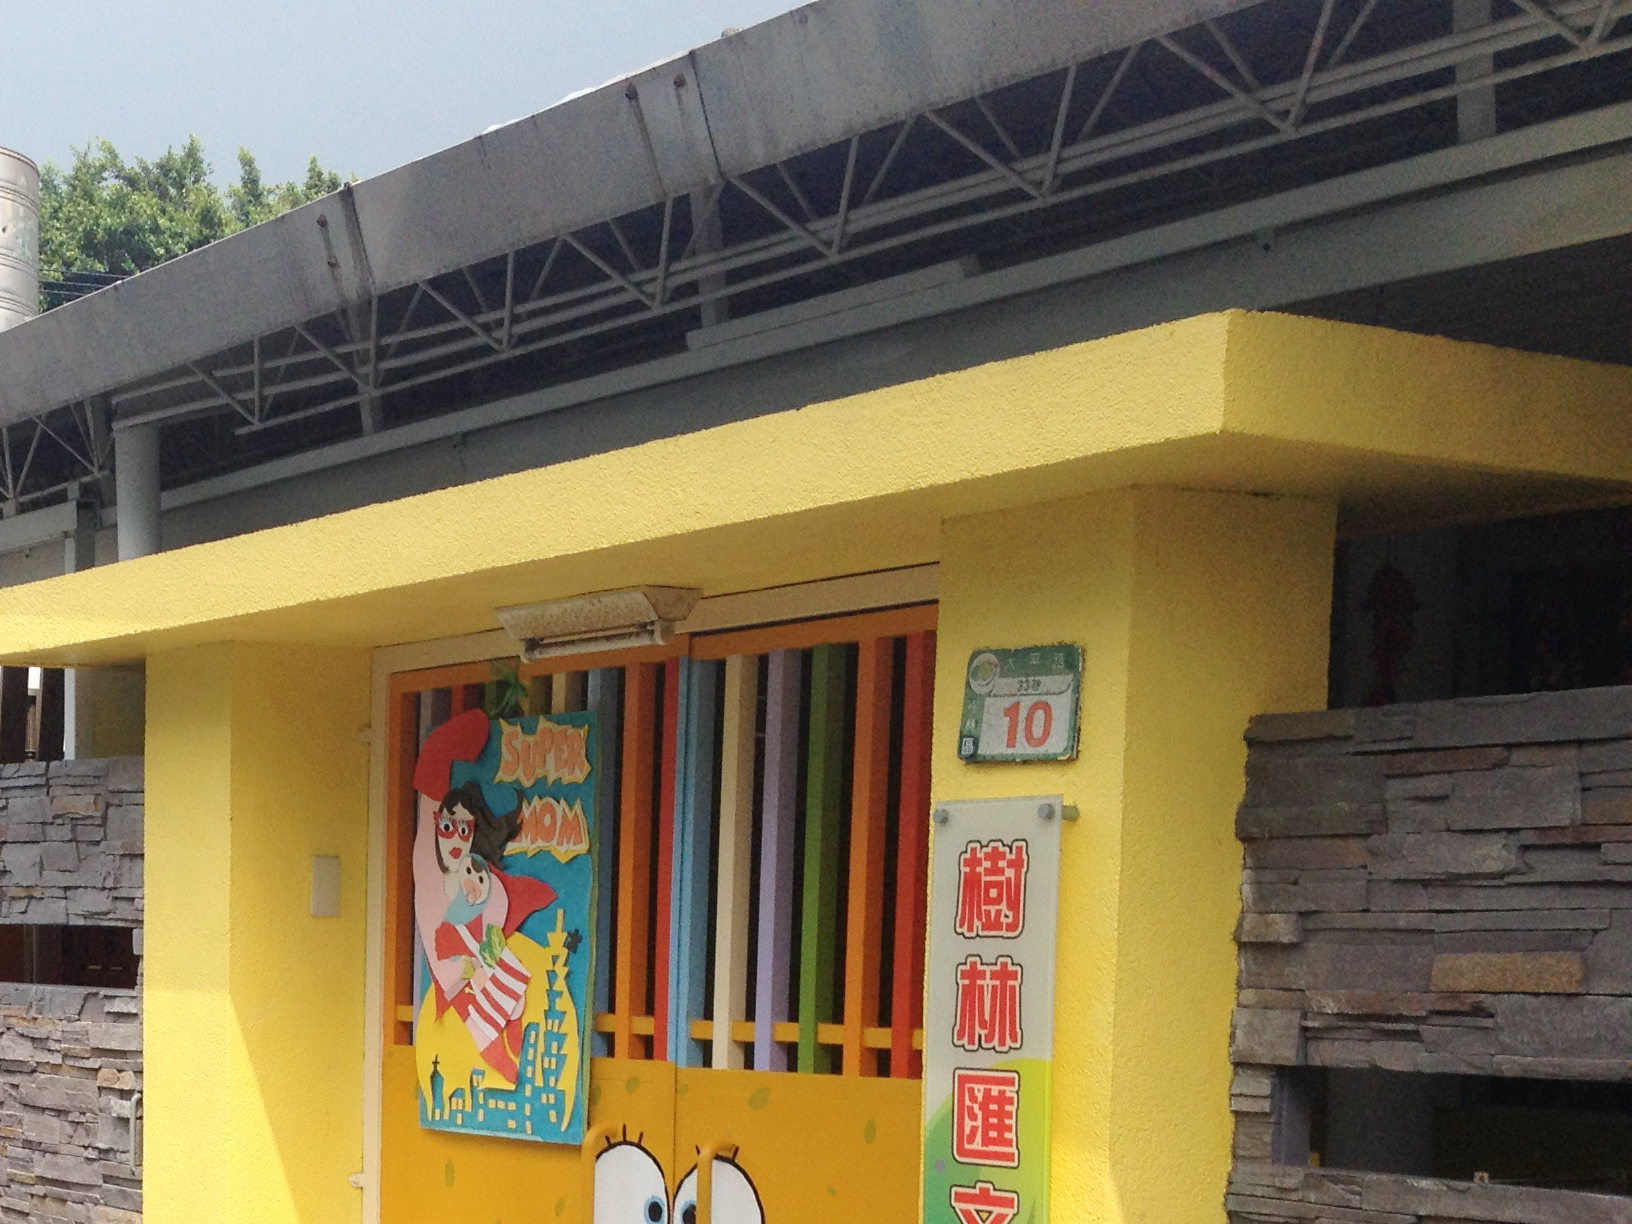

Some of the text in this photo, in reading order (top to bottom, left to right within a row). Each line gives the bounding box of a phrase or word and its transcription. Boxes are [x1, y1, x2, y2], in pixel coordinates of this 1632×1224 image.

[1003, 701, 1053, 748] 10
[500, 726, 585, 782] SUPER
[511, 801, 583, 847] MOM
